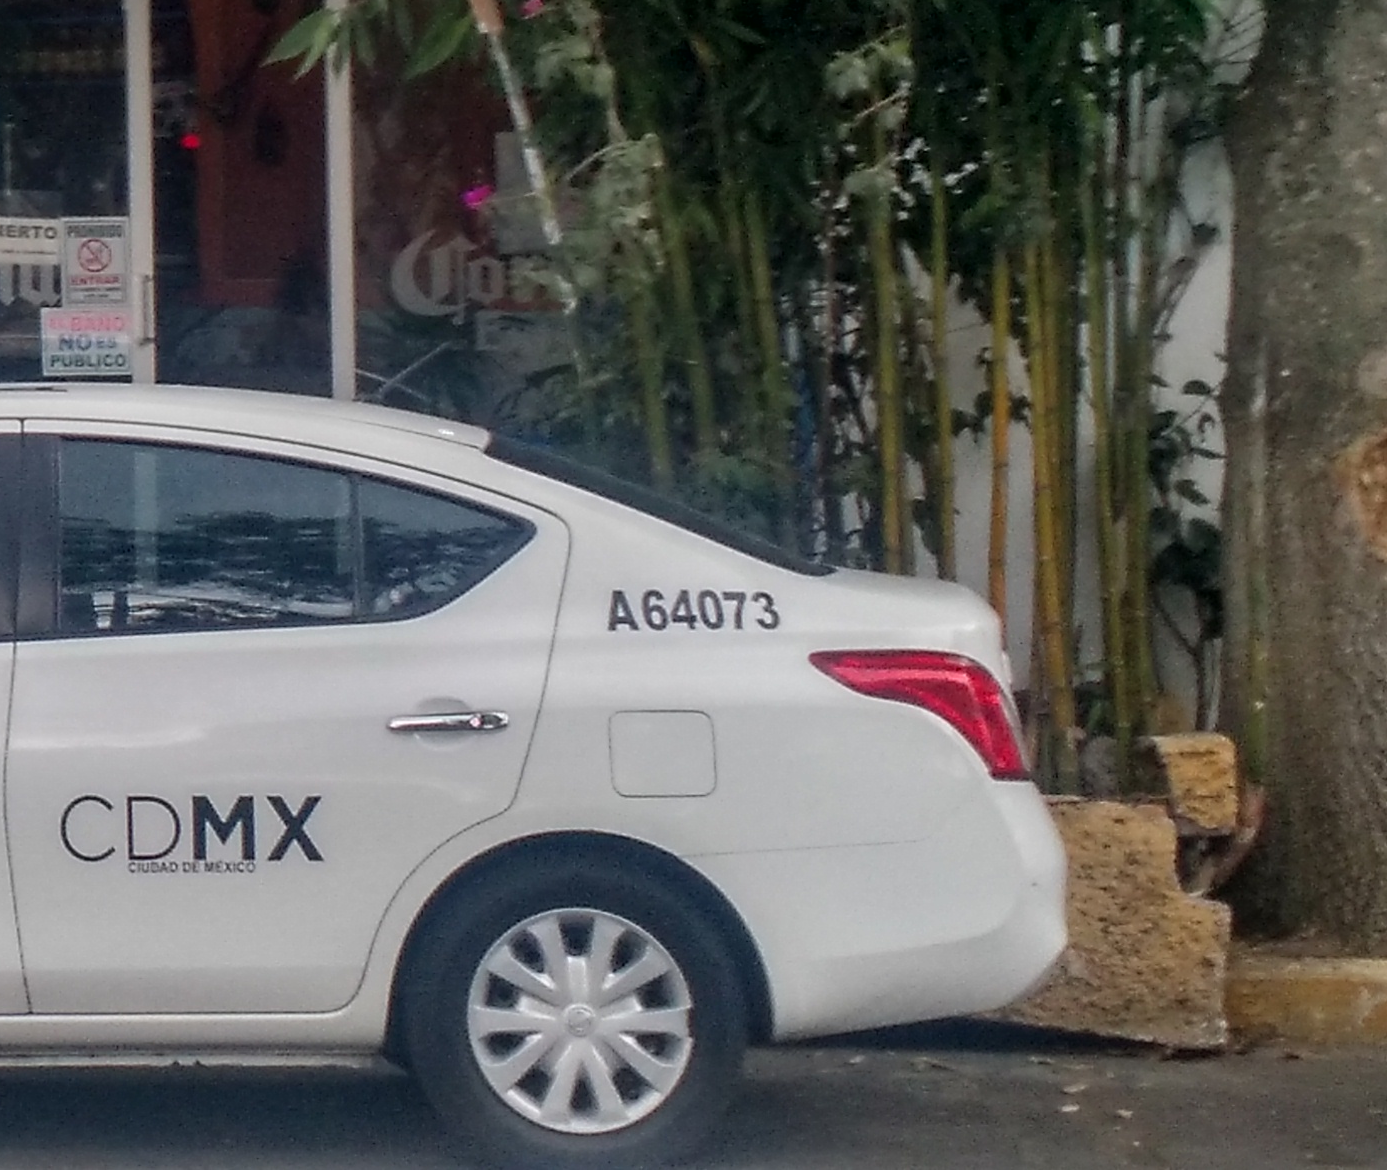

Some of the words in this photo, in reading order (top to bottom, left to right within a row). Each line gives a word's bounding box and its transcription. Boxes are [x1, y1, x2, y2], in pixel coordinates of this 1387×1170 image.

[59, 335, 92, 351] NO
[606, 588, 781, 633] A64073
[60, 794, 325, 863] CDMX
[128, 862, 178, 874] CIUDAD
[183, 862, 200, 874] DE
